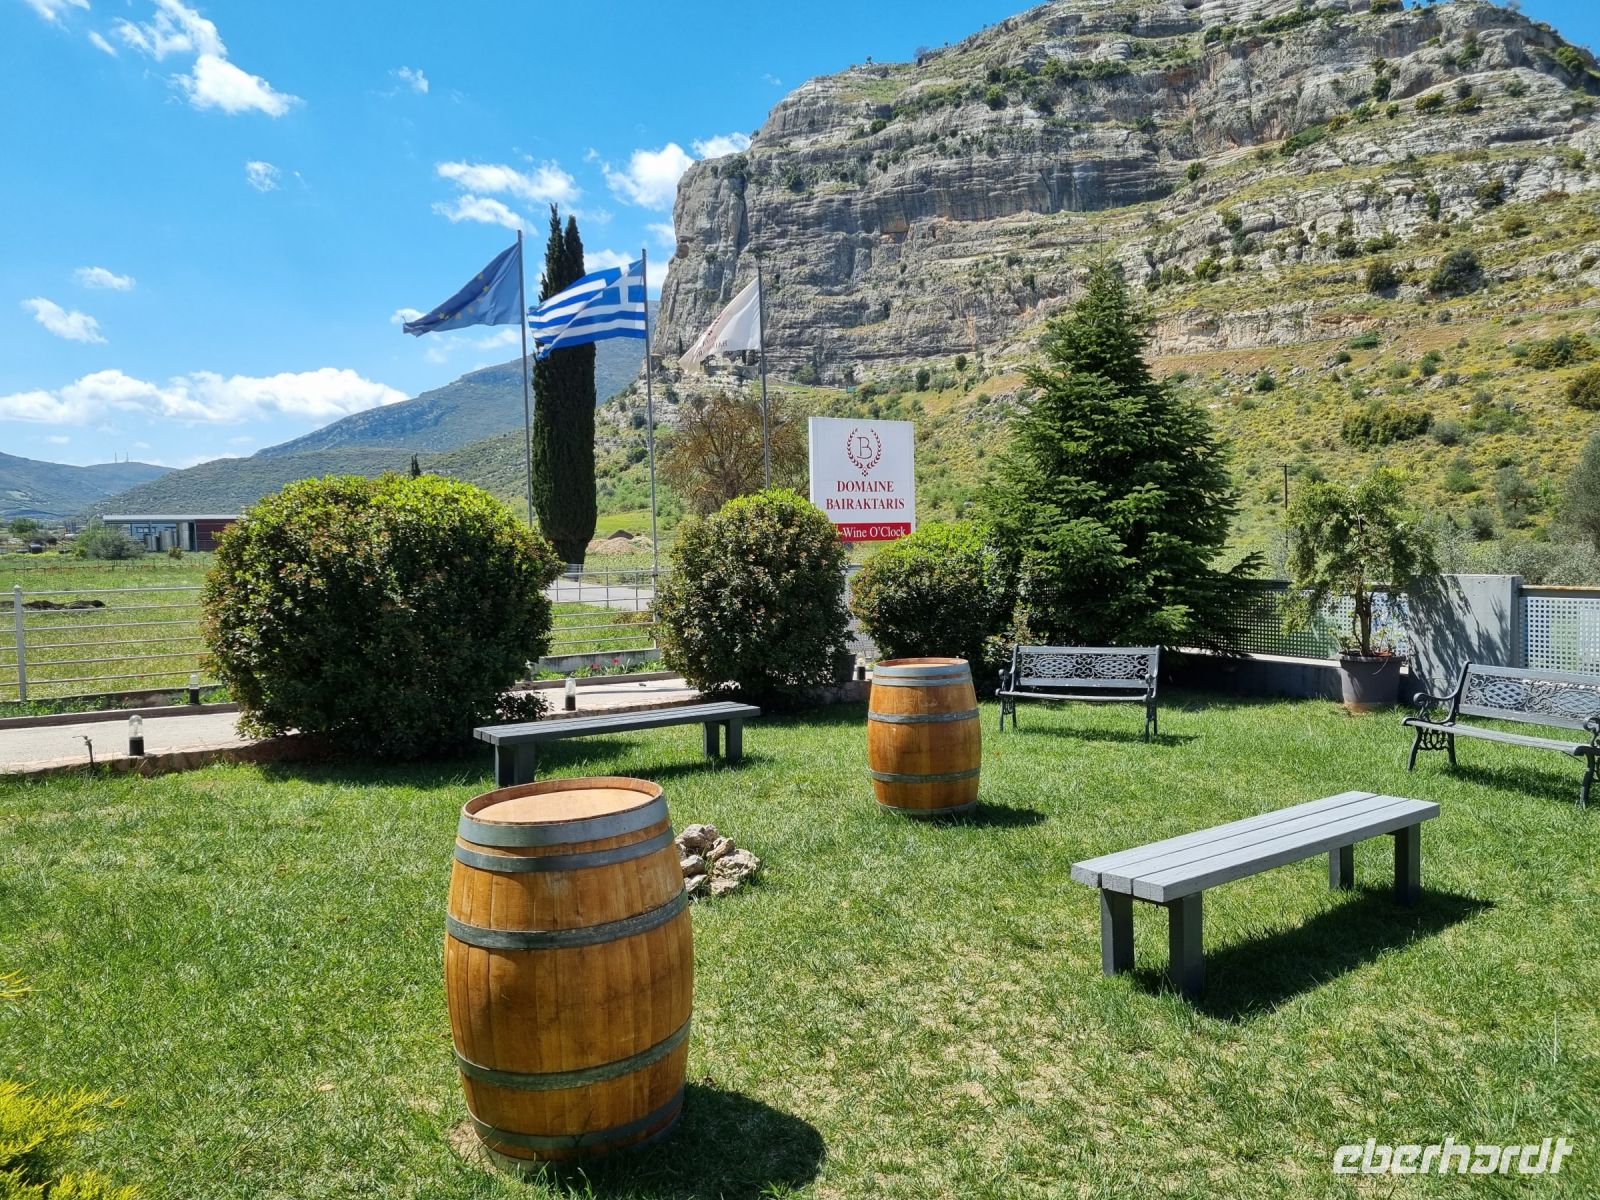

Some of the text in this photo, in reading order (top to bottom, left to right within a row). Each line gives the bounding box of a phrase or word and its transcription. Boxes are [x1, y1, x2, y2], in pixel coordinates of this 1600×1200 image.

[857, 436, 873, 460] B
[837, 480, 894, 493] DOMAINE
[826, 498, 905, 510] BAIRAKTARIS
[842, 524, 906, 538] Wine O'Clock
